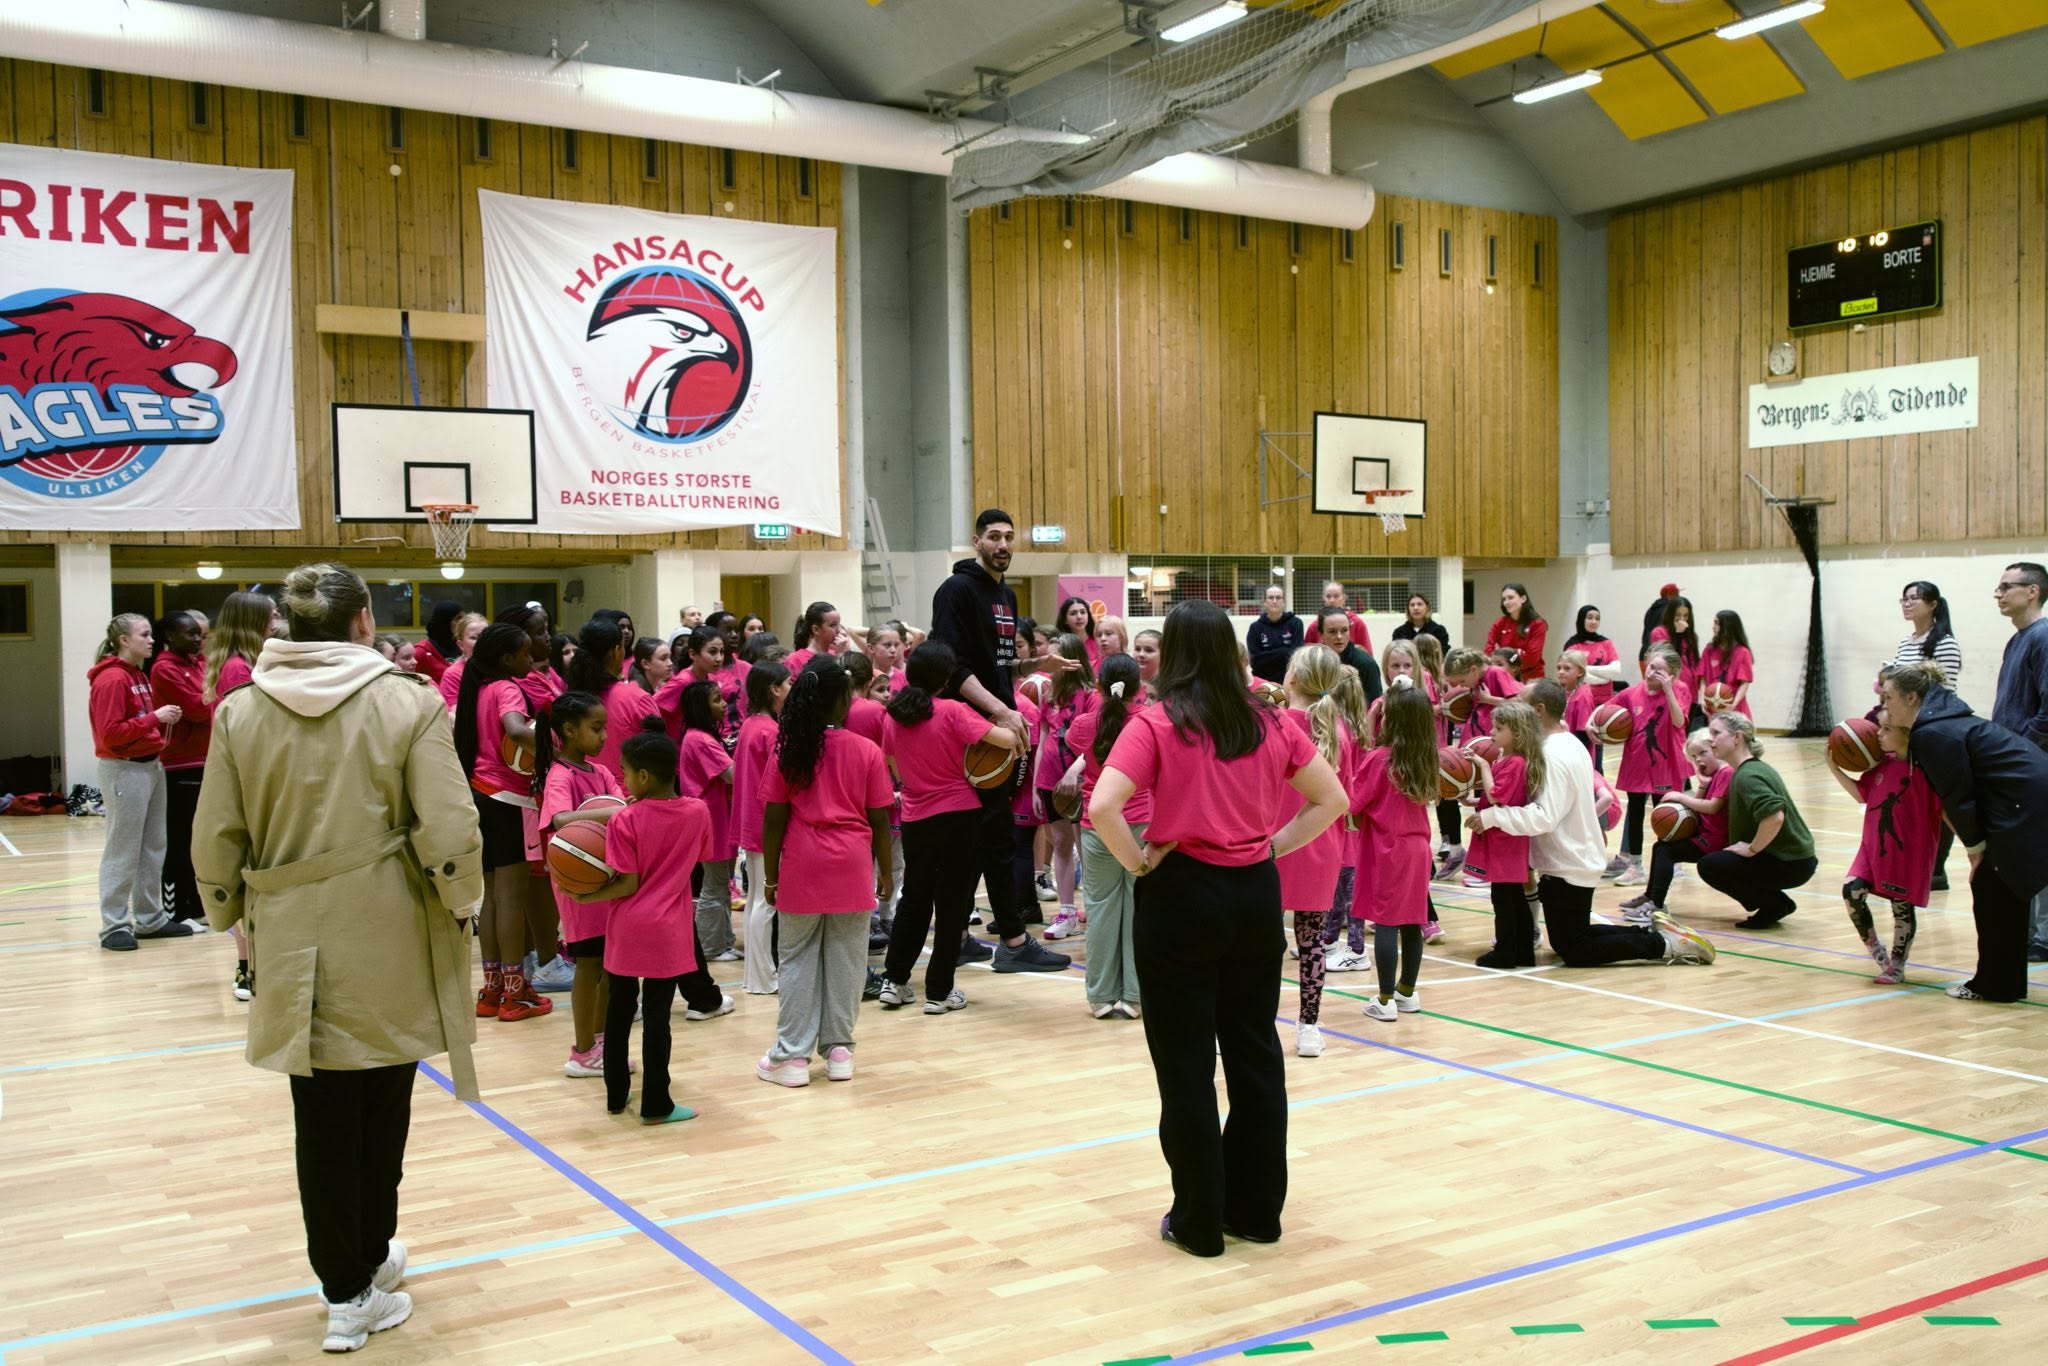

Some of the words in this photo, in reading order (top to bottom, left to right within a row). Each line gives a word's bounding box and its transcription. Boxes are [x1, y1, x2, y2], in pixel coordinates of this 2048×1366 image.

[1883, 247, 1922, 269] BORTE
[563, 235, 765, 313] HANSACUP
[1800, 263, 1836, 284] HJEMME
[572, 366, 624, 442] BERGEN
[632, 381, 763, 458] BASKETFESTIVAL
[1758, 402, 1830, 429] Bergens
[1889, 382, 1968, 414] Tidende
[48, 460, 145, 496] ULRIKEN
[591, 470, 669, 486] NORGES
[675, 473, 752, 488] STØRSTE
[560, 491, 780, 510] BASKETBALLTURNERING
